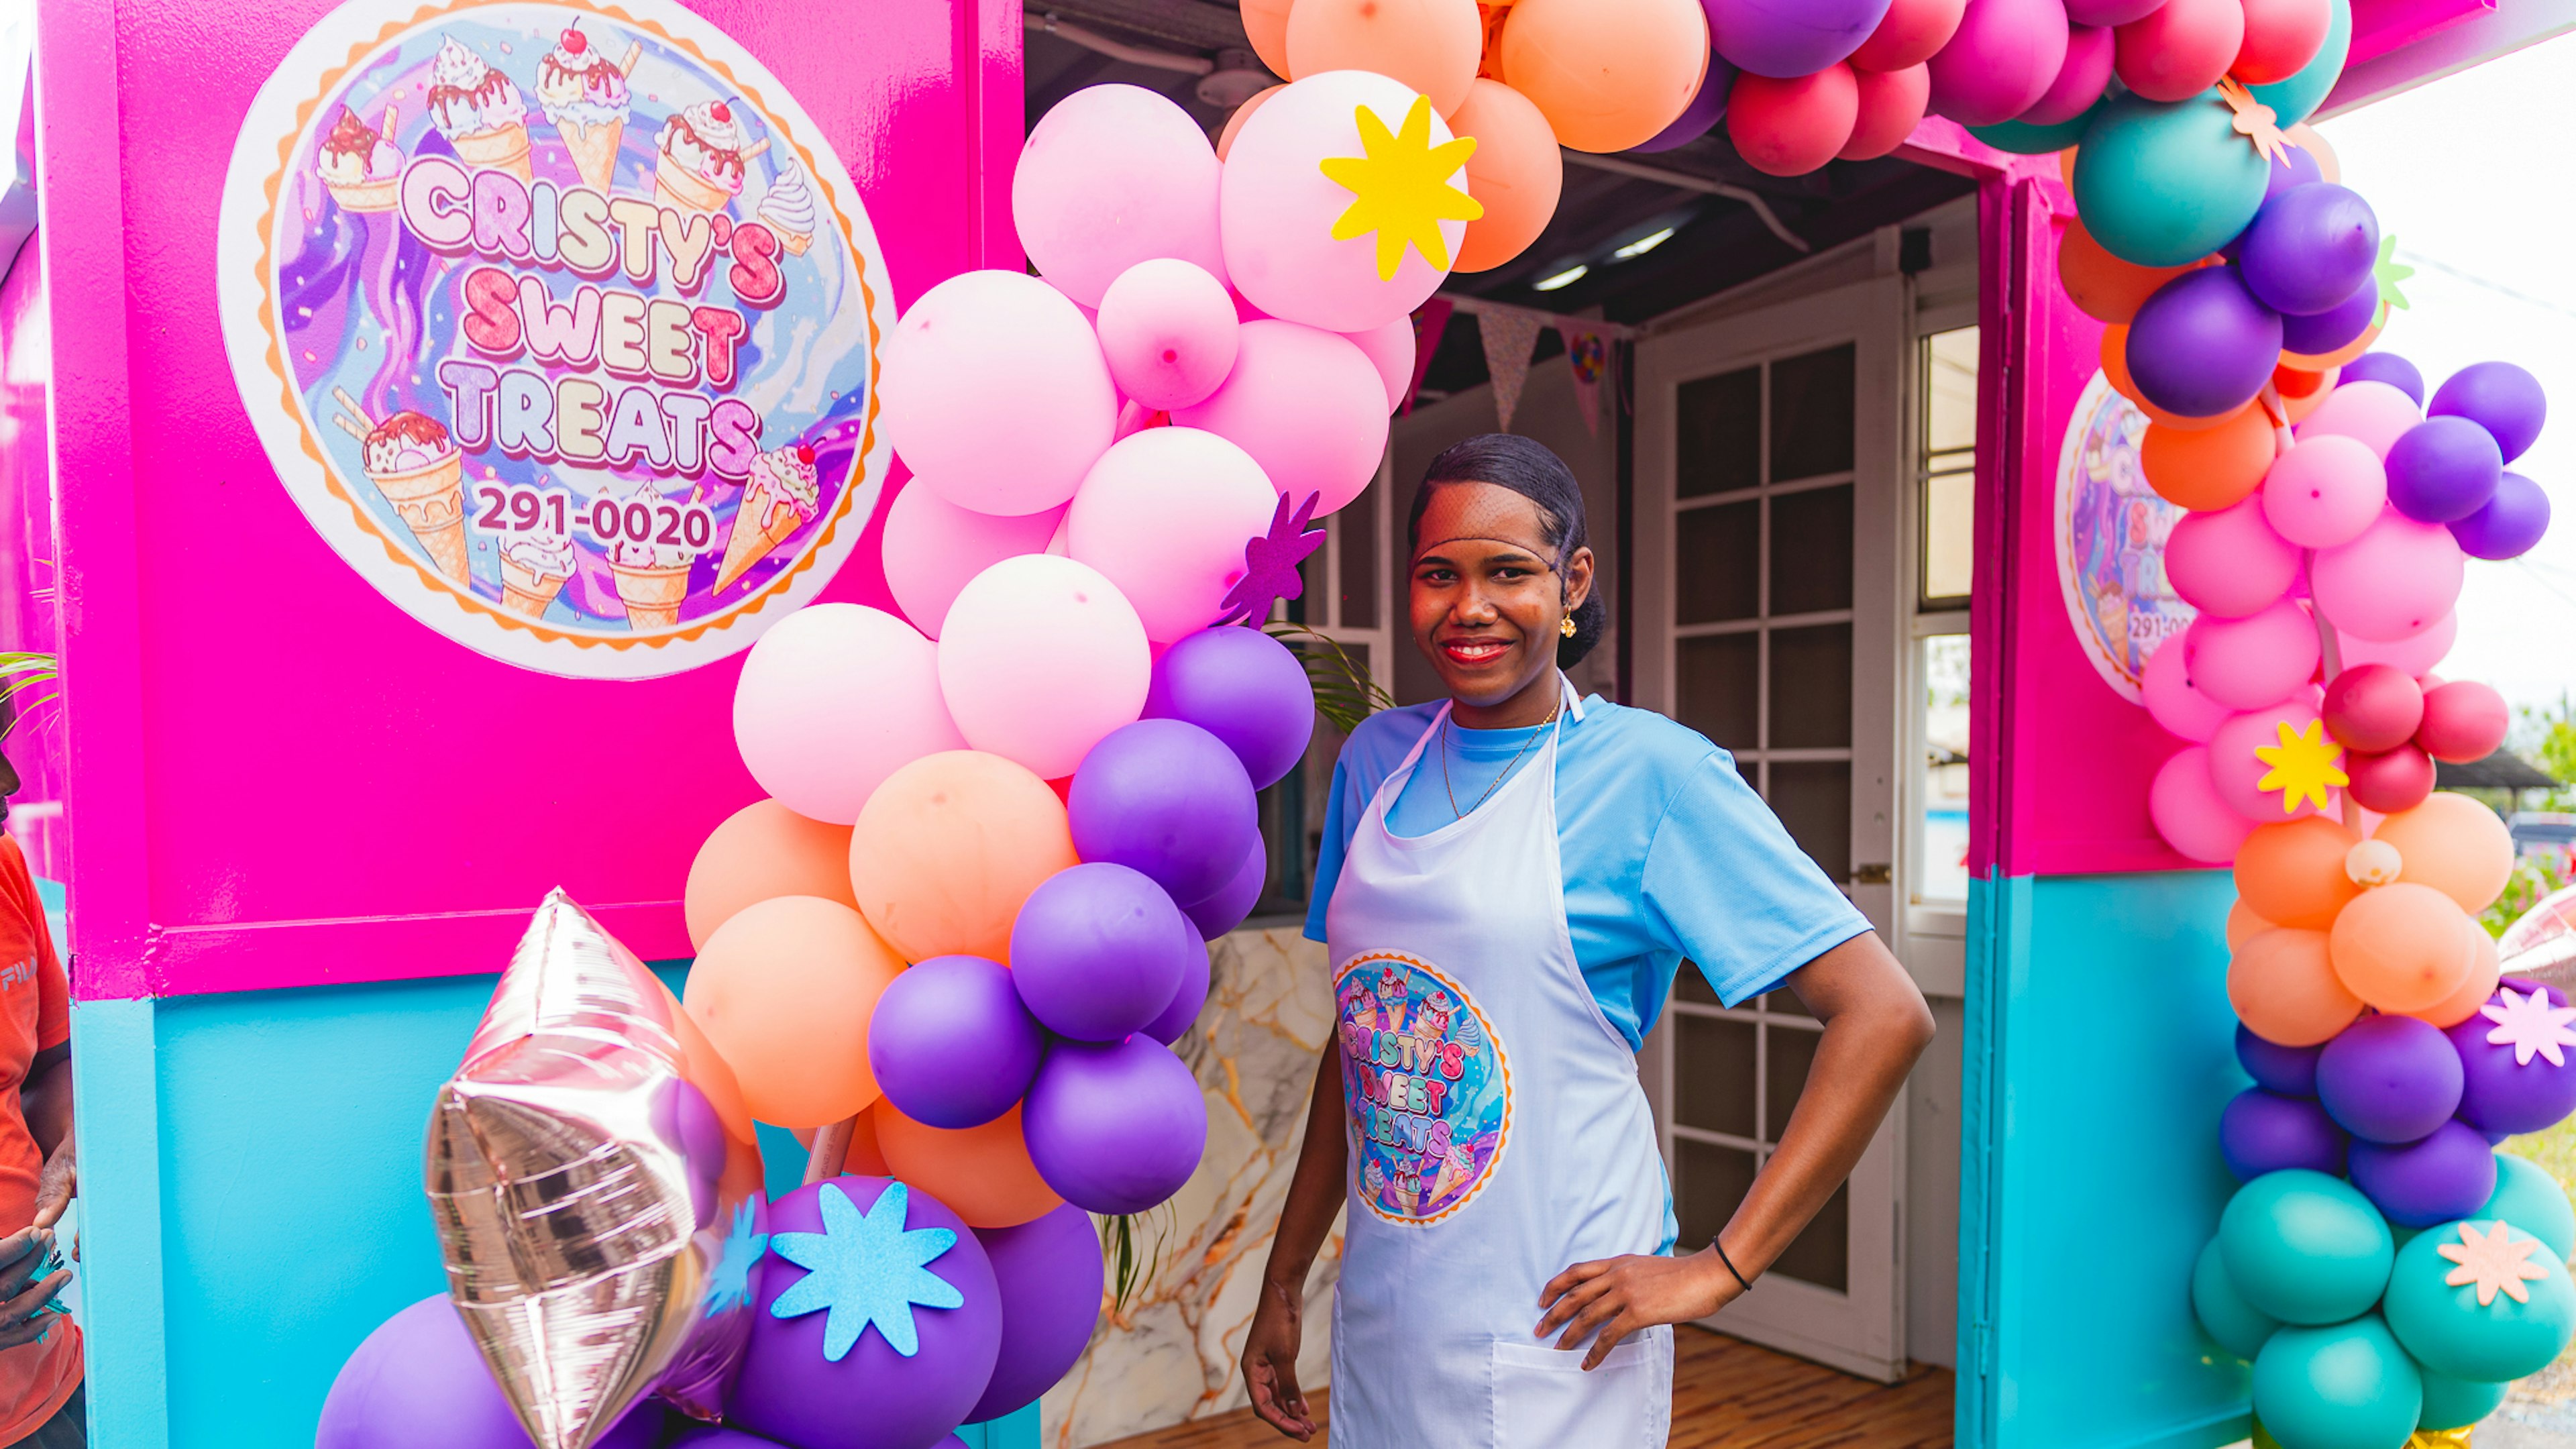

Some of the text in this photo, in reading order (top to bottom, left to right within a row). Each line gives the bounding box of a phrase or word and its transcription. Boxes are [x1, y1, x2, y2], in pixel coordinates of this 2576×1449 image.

[400, 157, 782, 305] CRISTY'S
[463, 266, 743, 386] SWEET
[439, 360, 761, 478] TREATS
[478, 486, 710, 548] 291-0020
[1344, 1023, 1464, 1077] CRISTY'S
[1359, 1064, 1446, 1114] SWEET
[1358, 1098, 1451, 1157] TREATS
